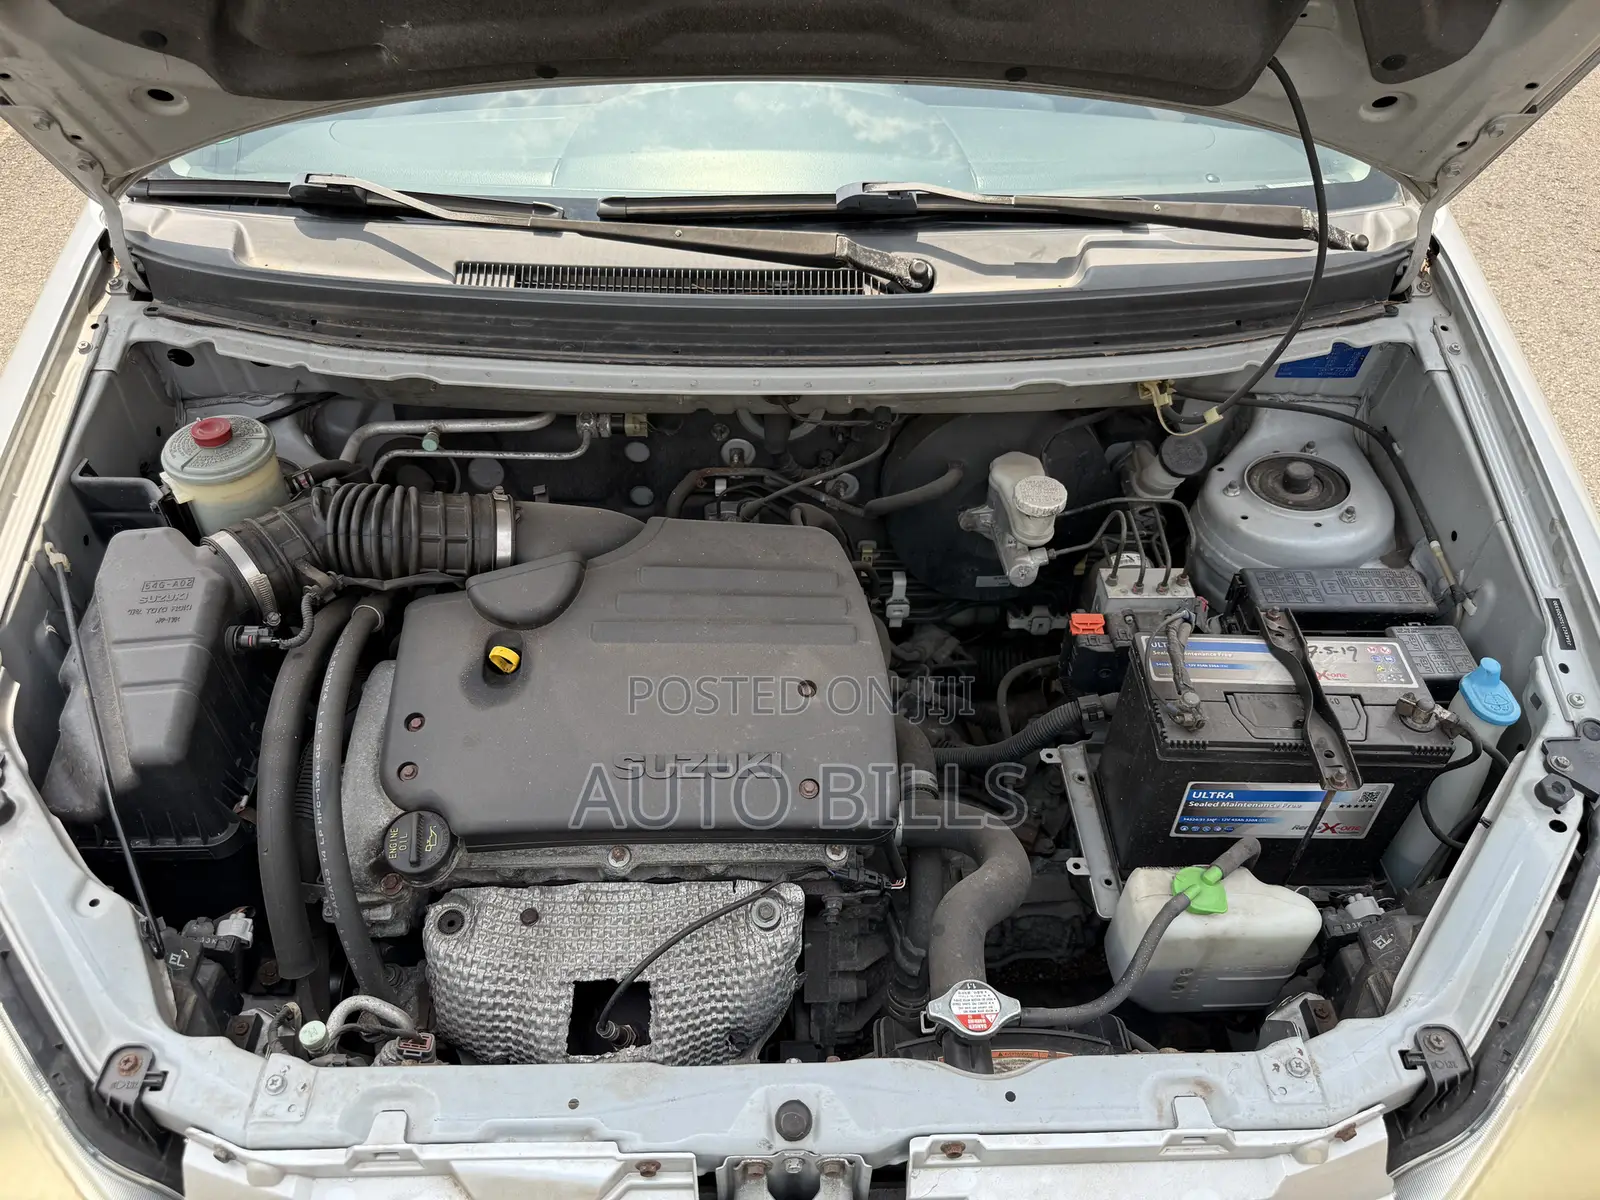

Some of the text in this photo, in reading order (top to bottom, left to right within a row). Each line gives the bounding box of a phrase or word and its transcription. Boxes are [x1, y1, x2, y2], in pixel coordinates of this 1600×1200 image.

[139, 593, 189, 604] SUZUKI
[612, 752, 783, 780] SUZUKI
[1192, 791, 1235, 799] ULTRA
[1188, 800, 1220, 808] Sealed
[388, 827, 399, 860] ENGINE
[399, 833, 408, 851] OIL
